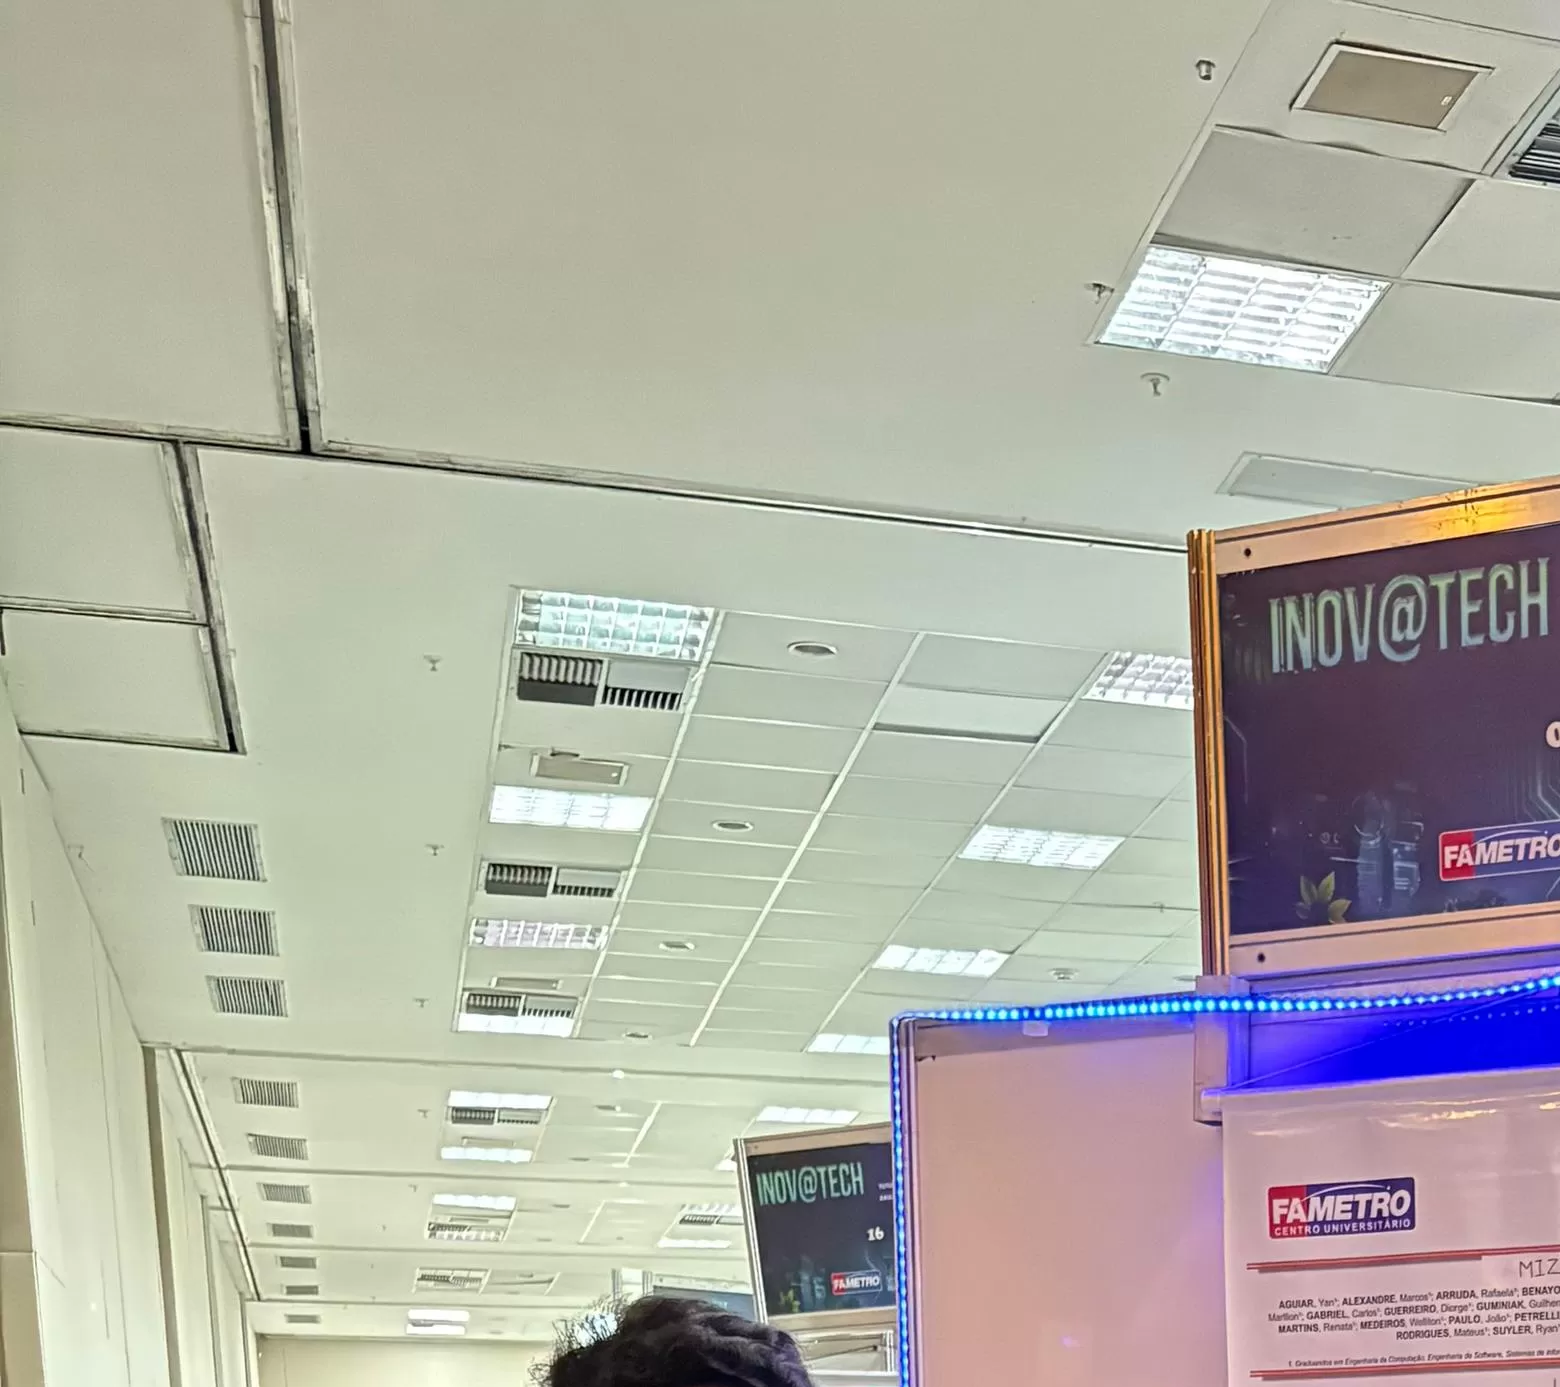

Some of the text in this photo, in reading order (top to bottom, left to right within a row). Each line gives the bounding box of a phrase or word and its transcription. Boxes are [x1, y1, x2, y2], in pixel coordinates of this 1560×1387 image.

[1268, 557, 1552, 674] INOV@TECH
[756, 1162, 864, 1206] INOV@TECH
[1273, 1189, 1411, 1224] FAMETRO
[867, 1226, 884, 1241] 16
[1275, 1218, 1410, 1236] CENTRO UNIVERSITÁRIO
